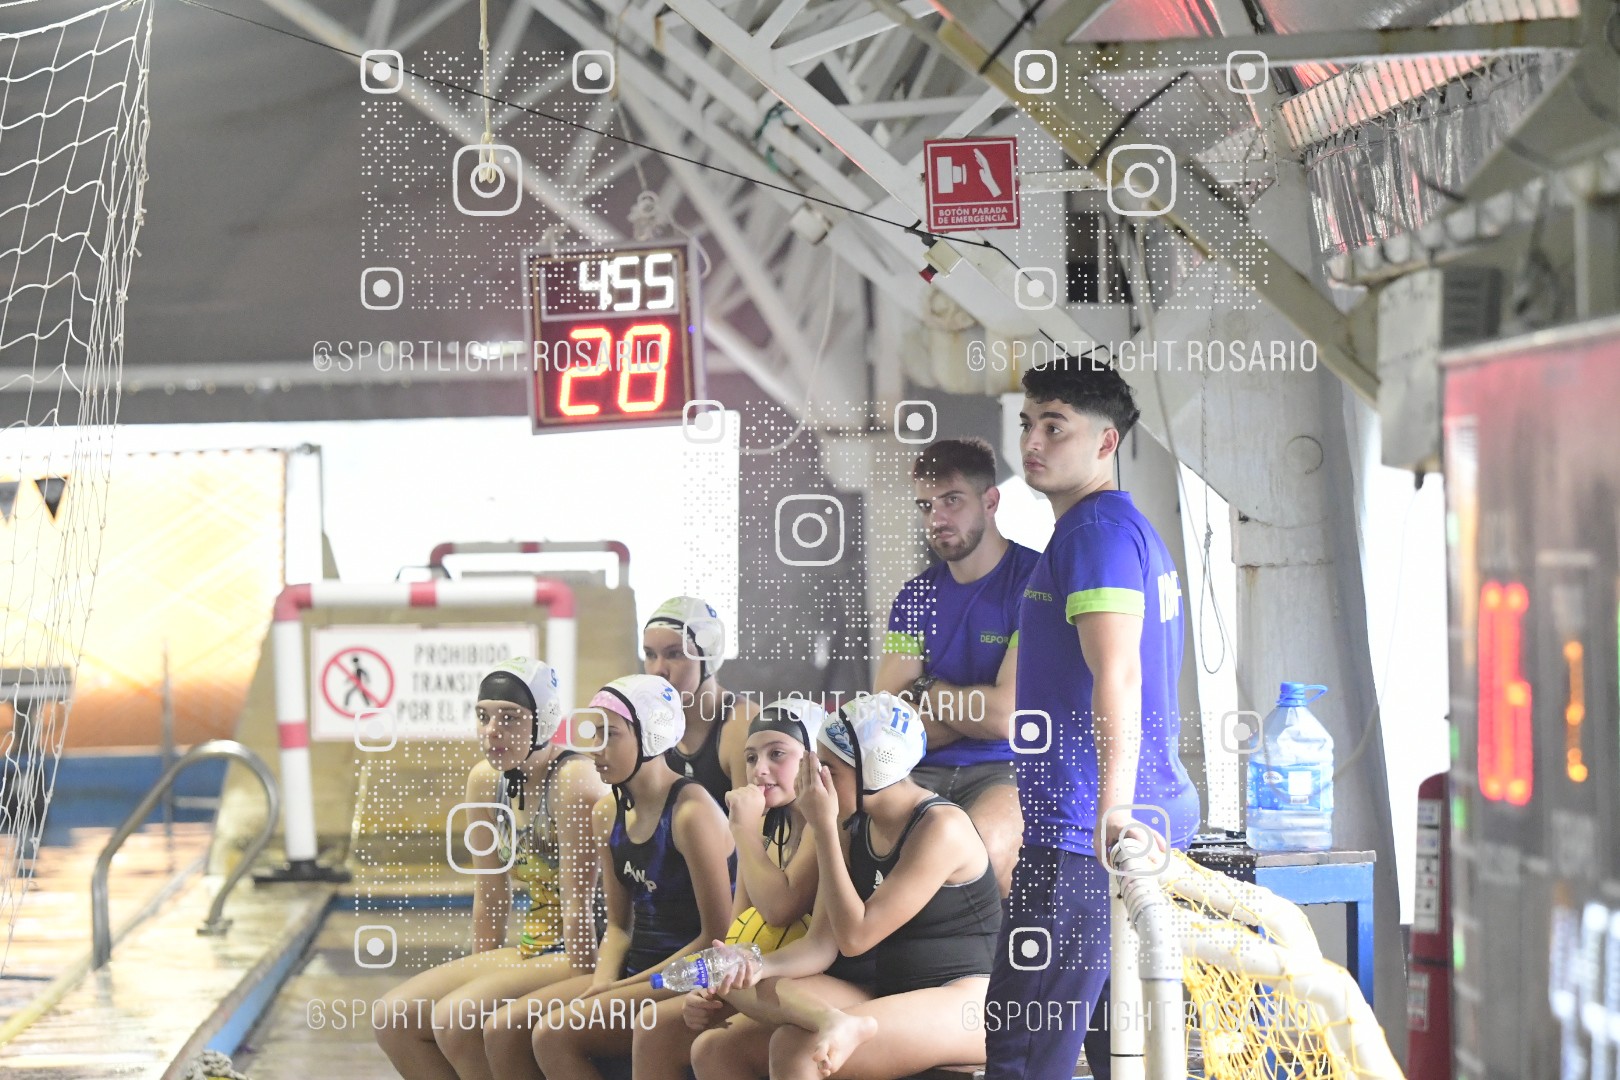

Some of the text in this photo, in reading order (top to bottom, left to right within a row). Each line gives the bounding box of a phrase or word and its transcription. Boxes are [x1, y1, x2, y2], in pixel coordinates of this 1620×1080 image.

[937, 213, 1007, 224] DE EMERGENCIA
[938, 206, 1008, 217] BOTÓN PARADA
[559, 323, 671, 417] 28
[413, 644, 508, 666] PROHIBIDO
[412, 671, 485, 693] TRANSIT
[397, 700, 430, 721] POR
[438, 700, 455, 721] EL
